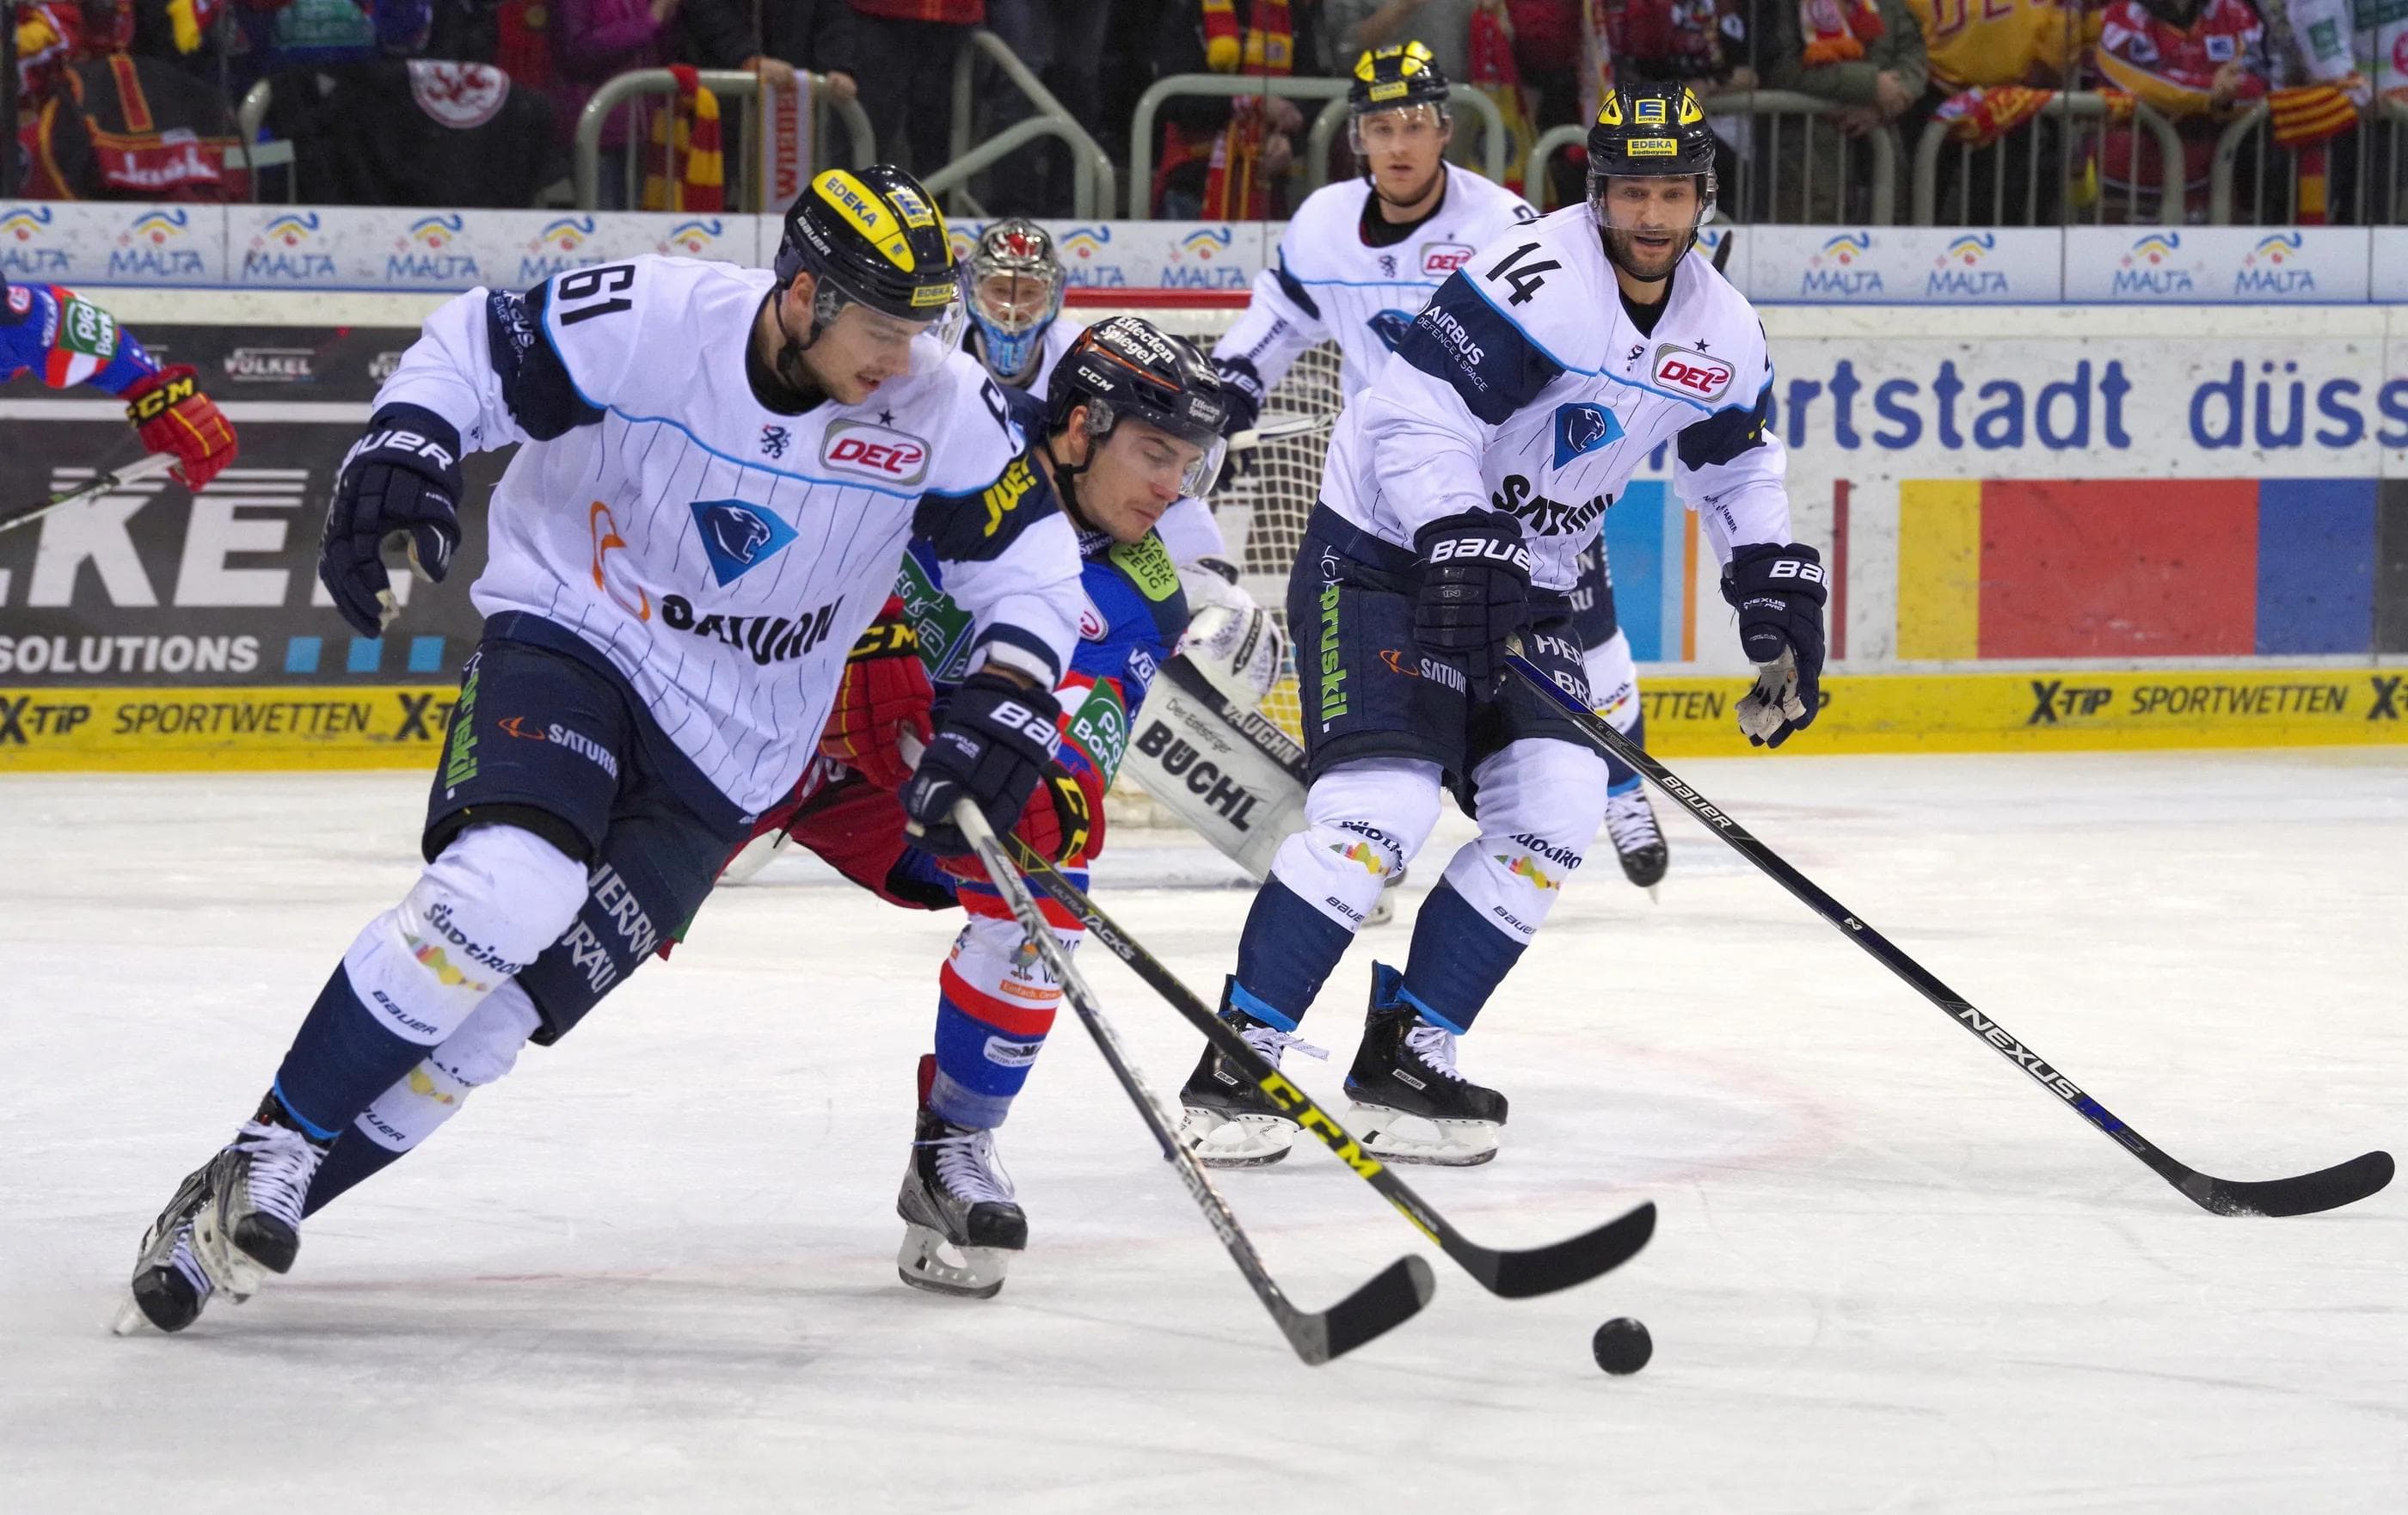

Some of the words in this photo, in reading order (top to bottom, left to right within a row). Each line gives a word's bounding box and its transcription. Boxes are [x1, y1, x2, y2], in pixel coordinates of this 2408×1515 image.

[1631, 140, 1673, 149] EDEKA
[825, 176, 878, 228] EDEKA
[108, 252, 205, 278] MALTA
[243, 254, 336, 280] MALTA
[387, 255, 480, 281] MALTA
[1066, 265, 1126, 287] ALTA
[1160, 266, 1247, 289] MALTA
[1485, 242, 1562, 307] 14
[1802, 270, 1883, 296] MALTA
[1926, 270, 2008, 296] MALTA
[2112, 270, 2193, 296] MALTA
[2236, 270, 2315, 296] MALTA
[557, 264, 636, 327] 61
[1099, 324, 1158, 366] Spiegel
[1115, 316, 1176, 365] Effecten
[1425, 304, 1484, 366] AIRBUS
[1416, 316, 1457, 359] DEFENCE
[1454, 353, 1463, 363] &
[1459, 359, 1489, 393] SPACE
[1078, 365, 1115, 391] CCM
[1659, 359, 1730, 393] DEL
[1767, 359, 2131, 450] rtstadt
[828, 437, 923, 475] DEL
[1120, 547, 1162, 590] ZEUG
[1429, 537, 1531, 572] BAUE
[0, 636, 260, 673] SOLUTIONS
[1421, 658, 1467, 697] SATUR
[395, 693, 454, 743] X-T
[1165, 697, 1188, 720] Der
[2130, 685, 2350, 715] SPORTWETTEN
[113, 702, 372, 737] SPORTWETTEN
[1219, 704, 1301, 766] VAUGHN
[1135, 719, 1258, 832] BÜCHL
[1081, 912, 1137, 961] TACKS
[1958, 1007, 2081, 1100] NEXUS
[1258, 1070, 1384, 1179] CCM
